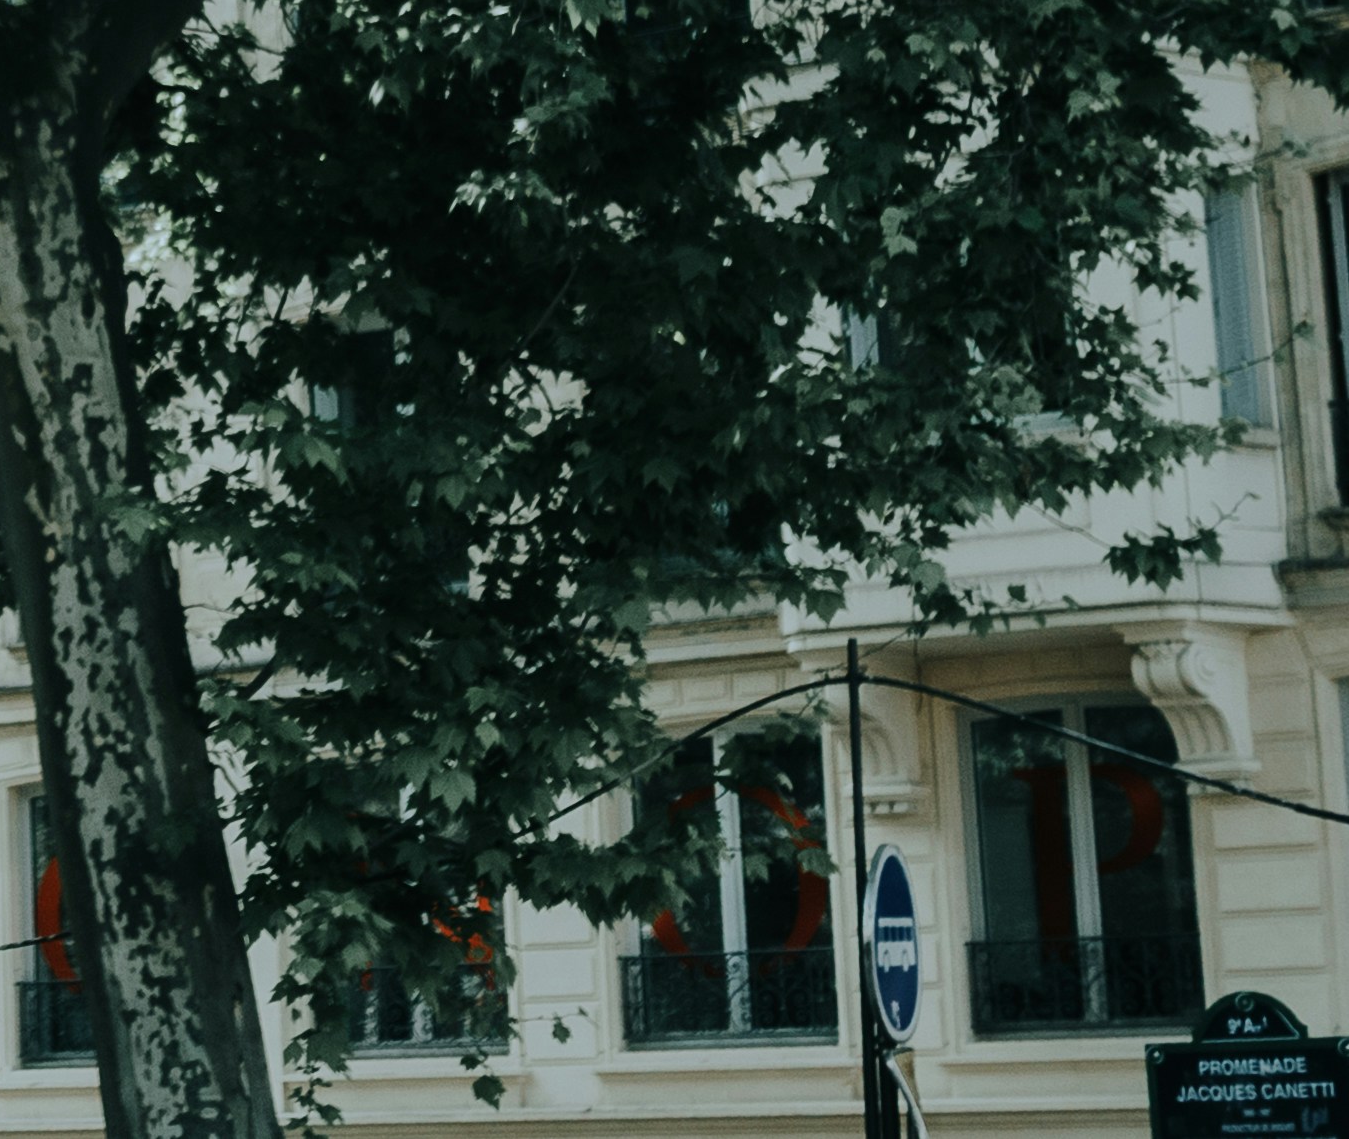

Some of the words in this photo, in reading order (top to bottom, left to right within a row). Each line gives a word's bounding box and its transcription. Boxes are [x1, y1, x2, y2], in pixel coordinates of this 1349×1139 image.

[1198, 1057, 1308, 1076] PROMENADE
[1176, 1082, 1257, 1103] JACQUES
[1260, 1081, 1336, 1100] CANETTI
